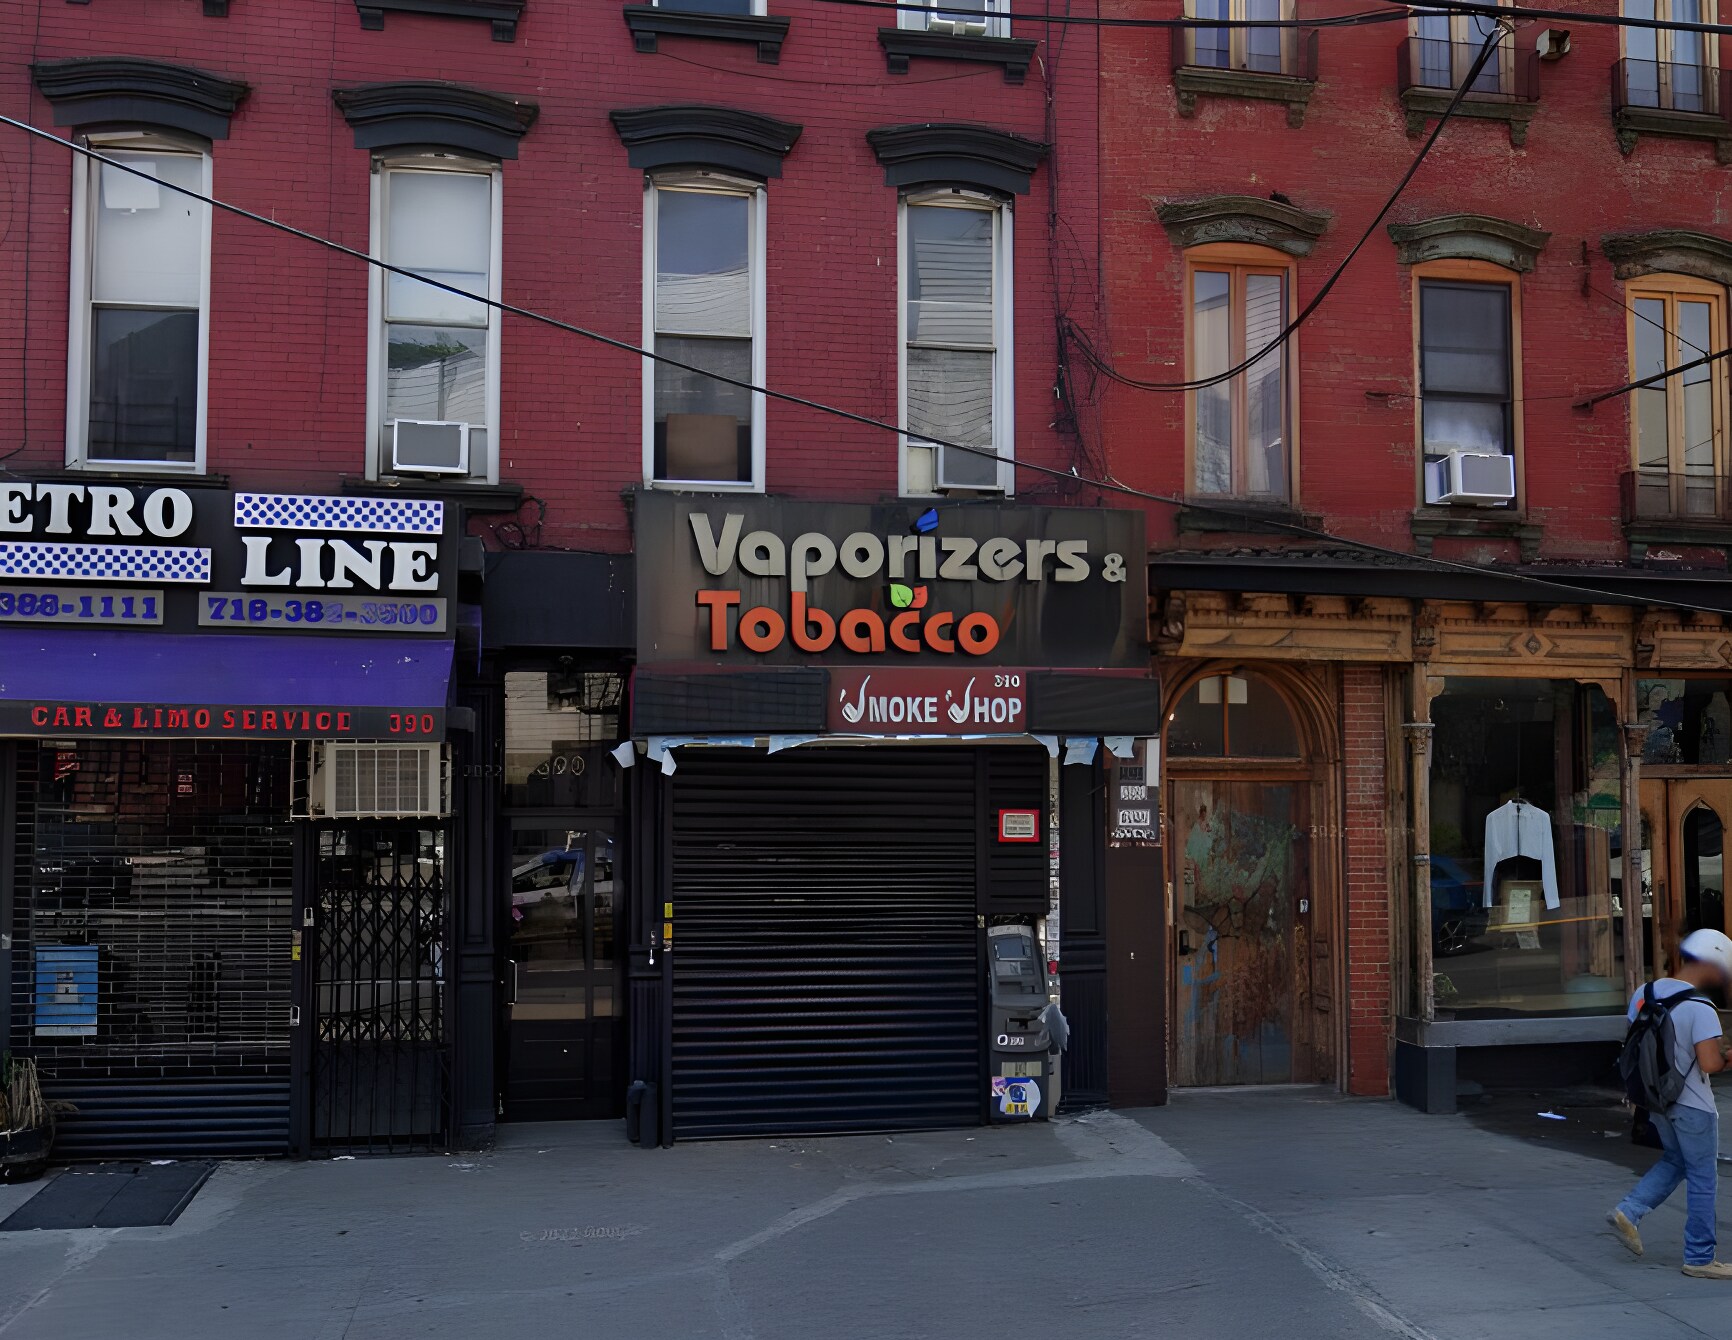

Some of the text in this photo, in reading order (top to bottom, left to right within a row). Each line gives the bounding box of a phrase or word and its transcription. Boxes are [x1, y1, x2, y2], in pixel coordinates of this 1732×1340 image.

[240, 535, 439, 591] LINE
[689, 512, 1127, 592] Vaporizers &
[696, 589, 1000, 656] Tobacco
[31, 706, 93, 727] CAR
[104, 707, 122, 728] &
[132, 707, 211, 729] LIMO
